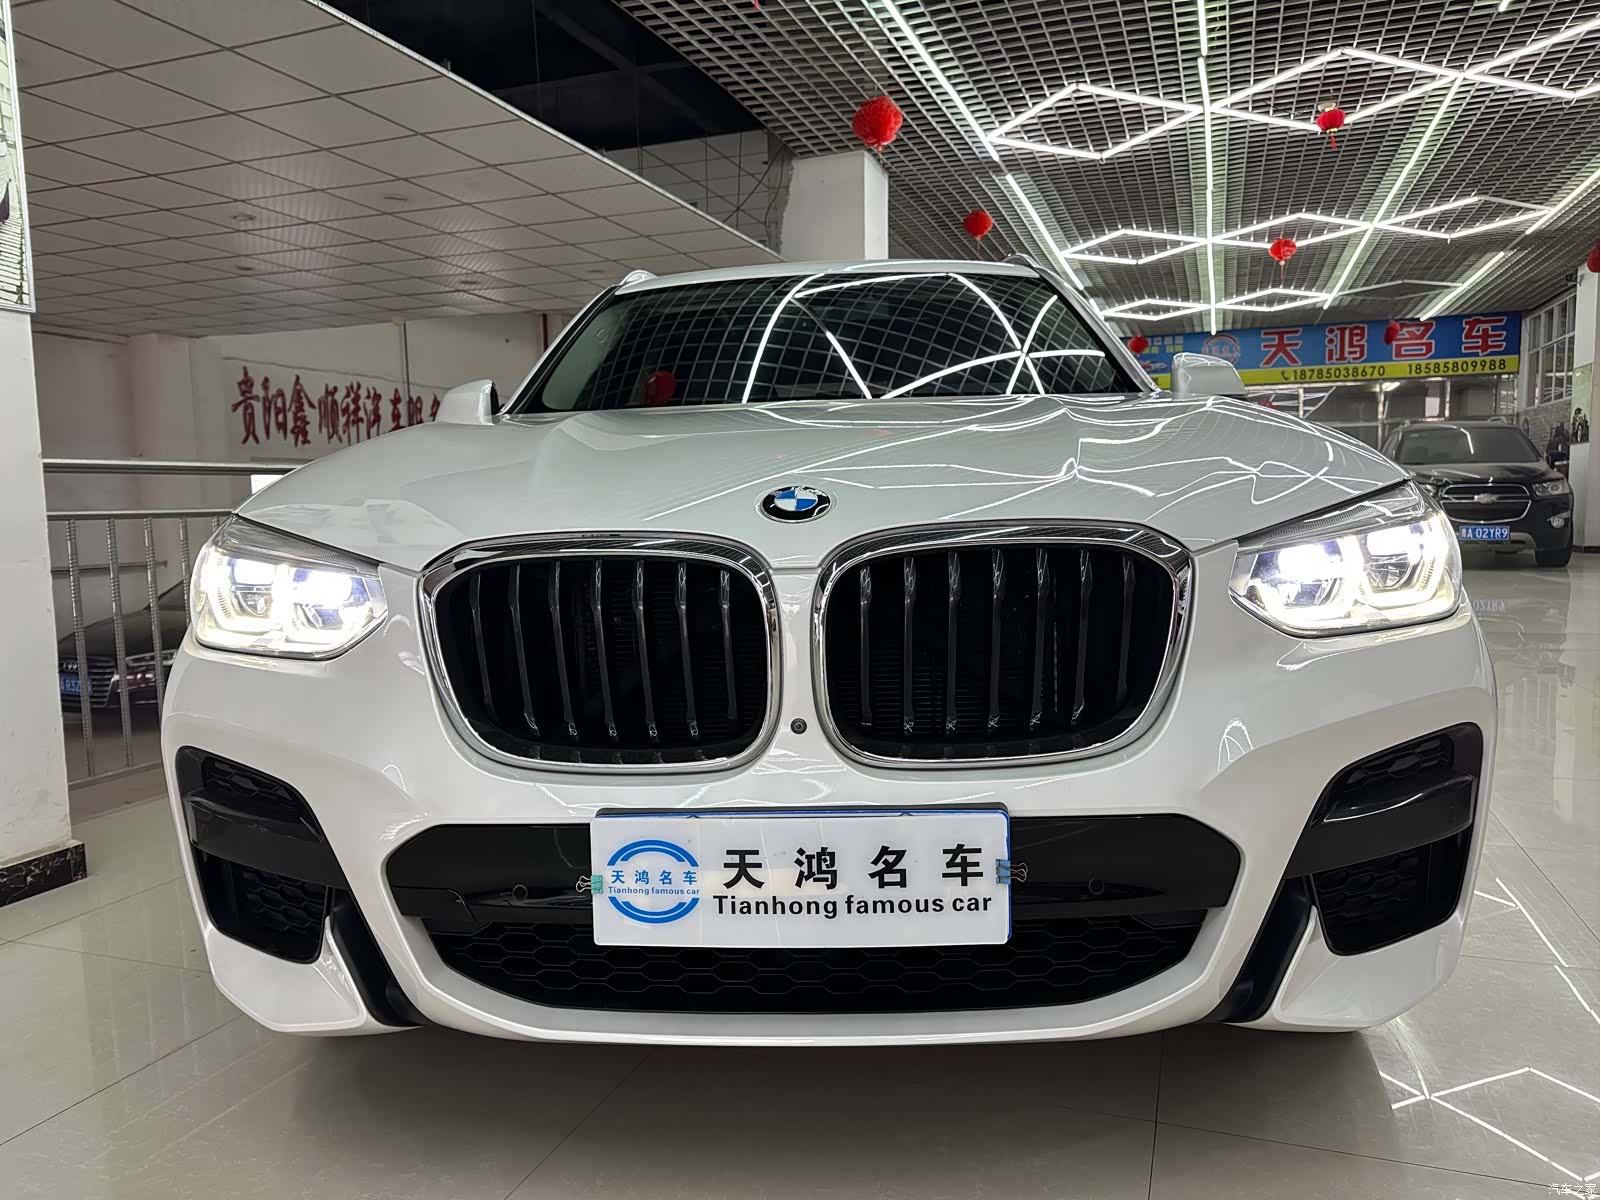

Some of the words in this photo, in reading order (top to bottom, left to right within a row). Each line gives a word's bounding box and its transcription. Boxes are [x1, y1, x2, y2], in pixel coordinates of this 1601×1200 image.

[1260, 316, 1507, 367] 天鸿名车
[1293, 366, 1385, 381] 18785038670
[1407, 358, 1507, 375] 18585809988
[611, 870, 697, 885] 天鸿名车
[723, 844, 984, 890] 天鸿名车
[608, 886, 650, 895] Tianhong
[651, 887, 685, 895] famous
[713, 895, 838, 919] Tianhong
[845, 895, 945, 915] famous
[952, 897, 992, 912] car
